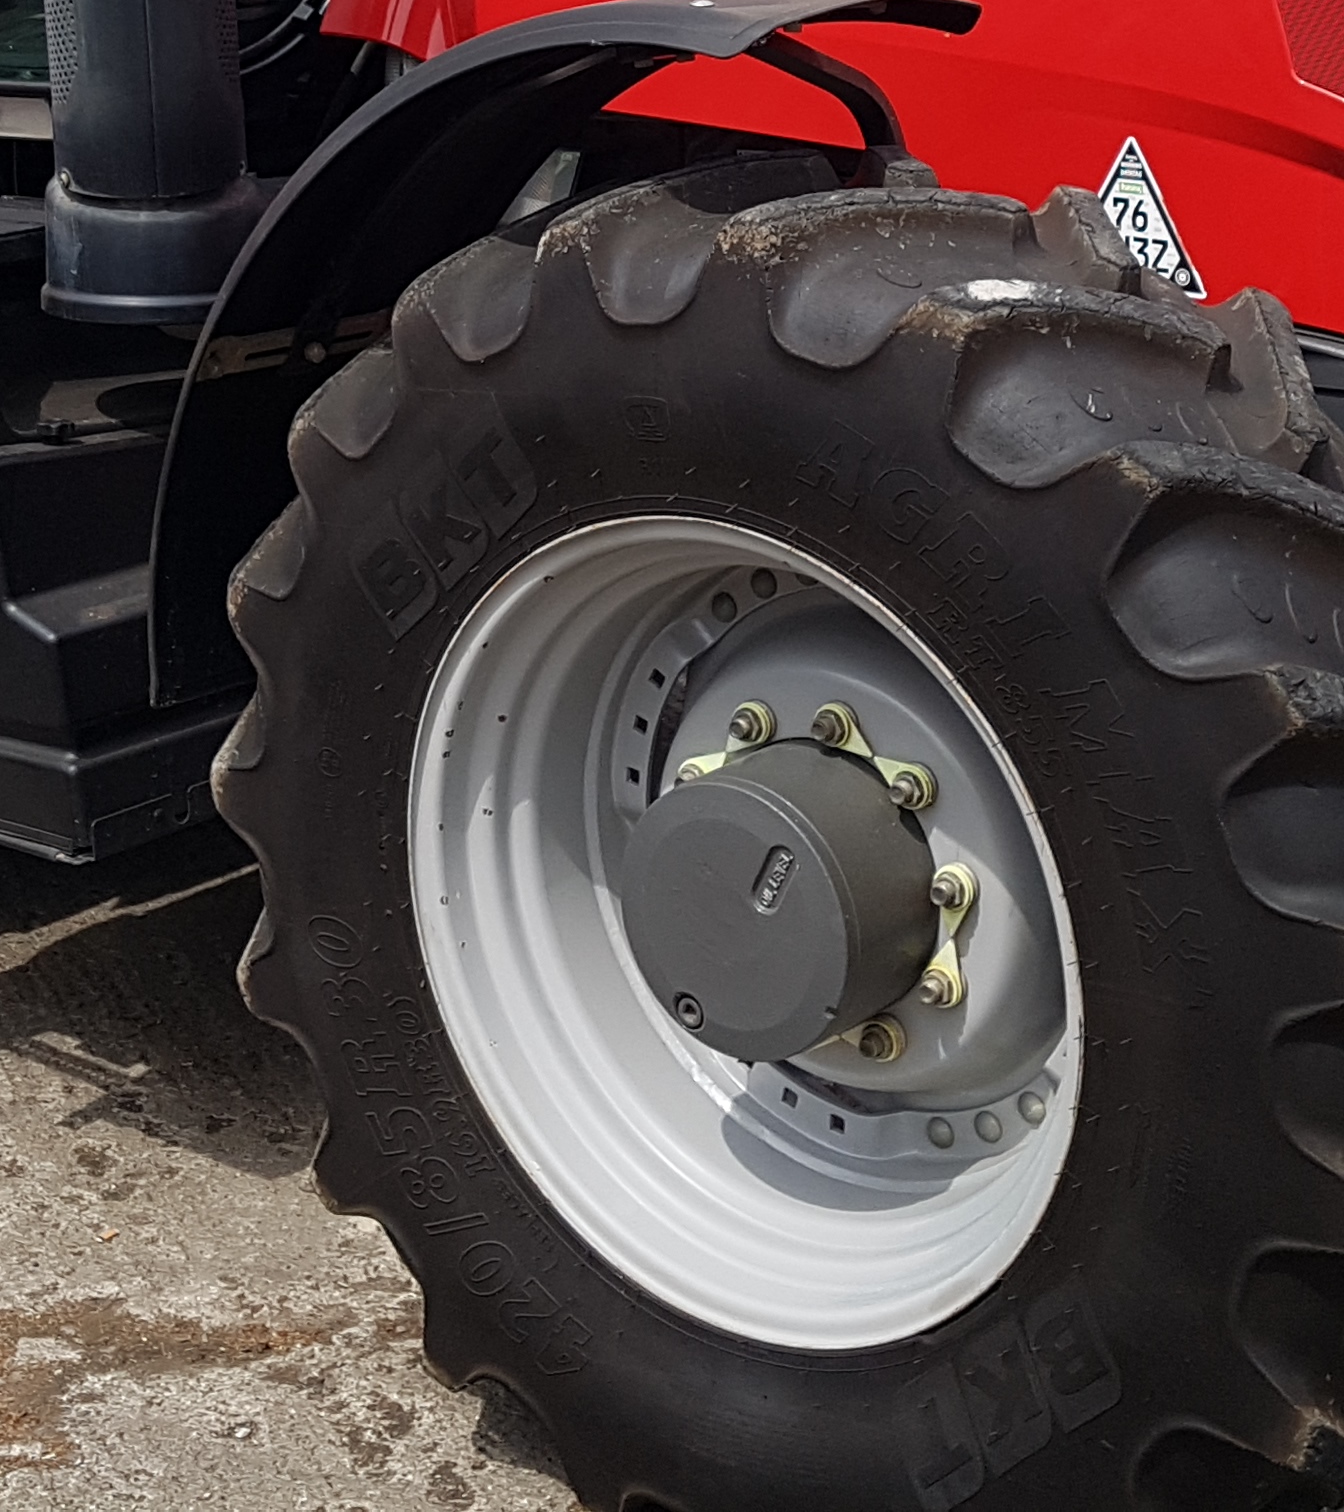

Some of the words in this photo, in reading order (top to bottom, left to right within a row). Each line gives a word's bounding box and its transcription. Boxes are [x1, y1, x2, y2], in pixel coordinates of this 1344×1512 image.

[1112, 197, 1149, 232] 76
[1125, 236, 1169, 273] 3Z
[354, 420, 524, 625] BKT
